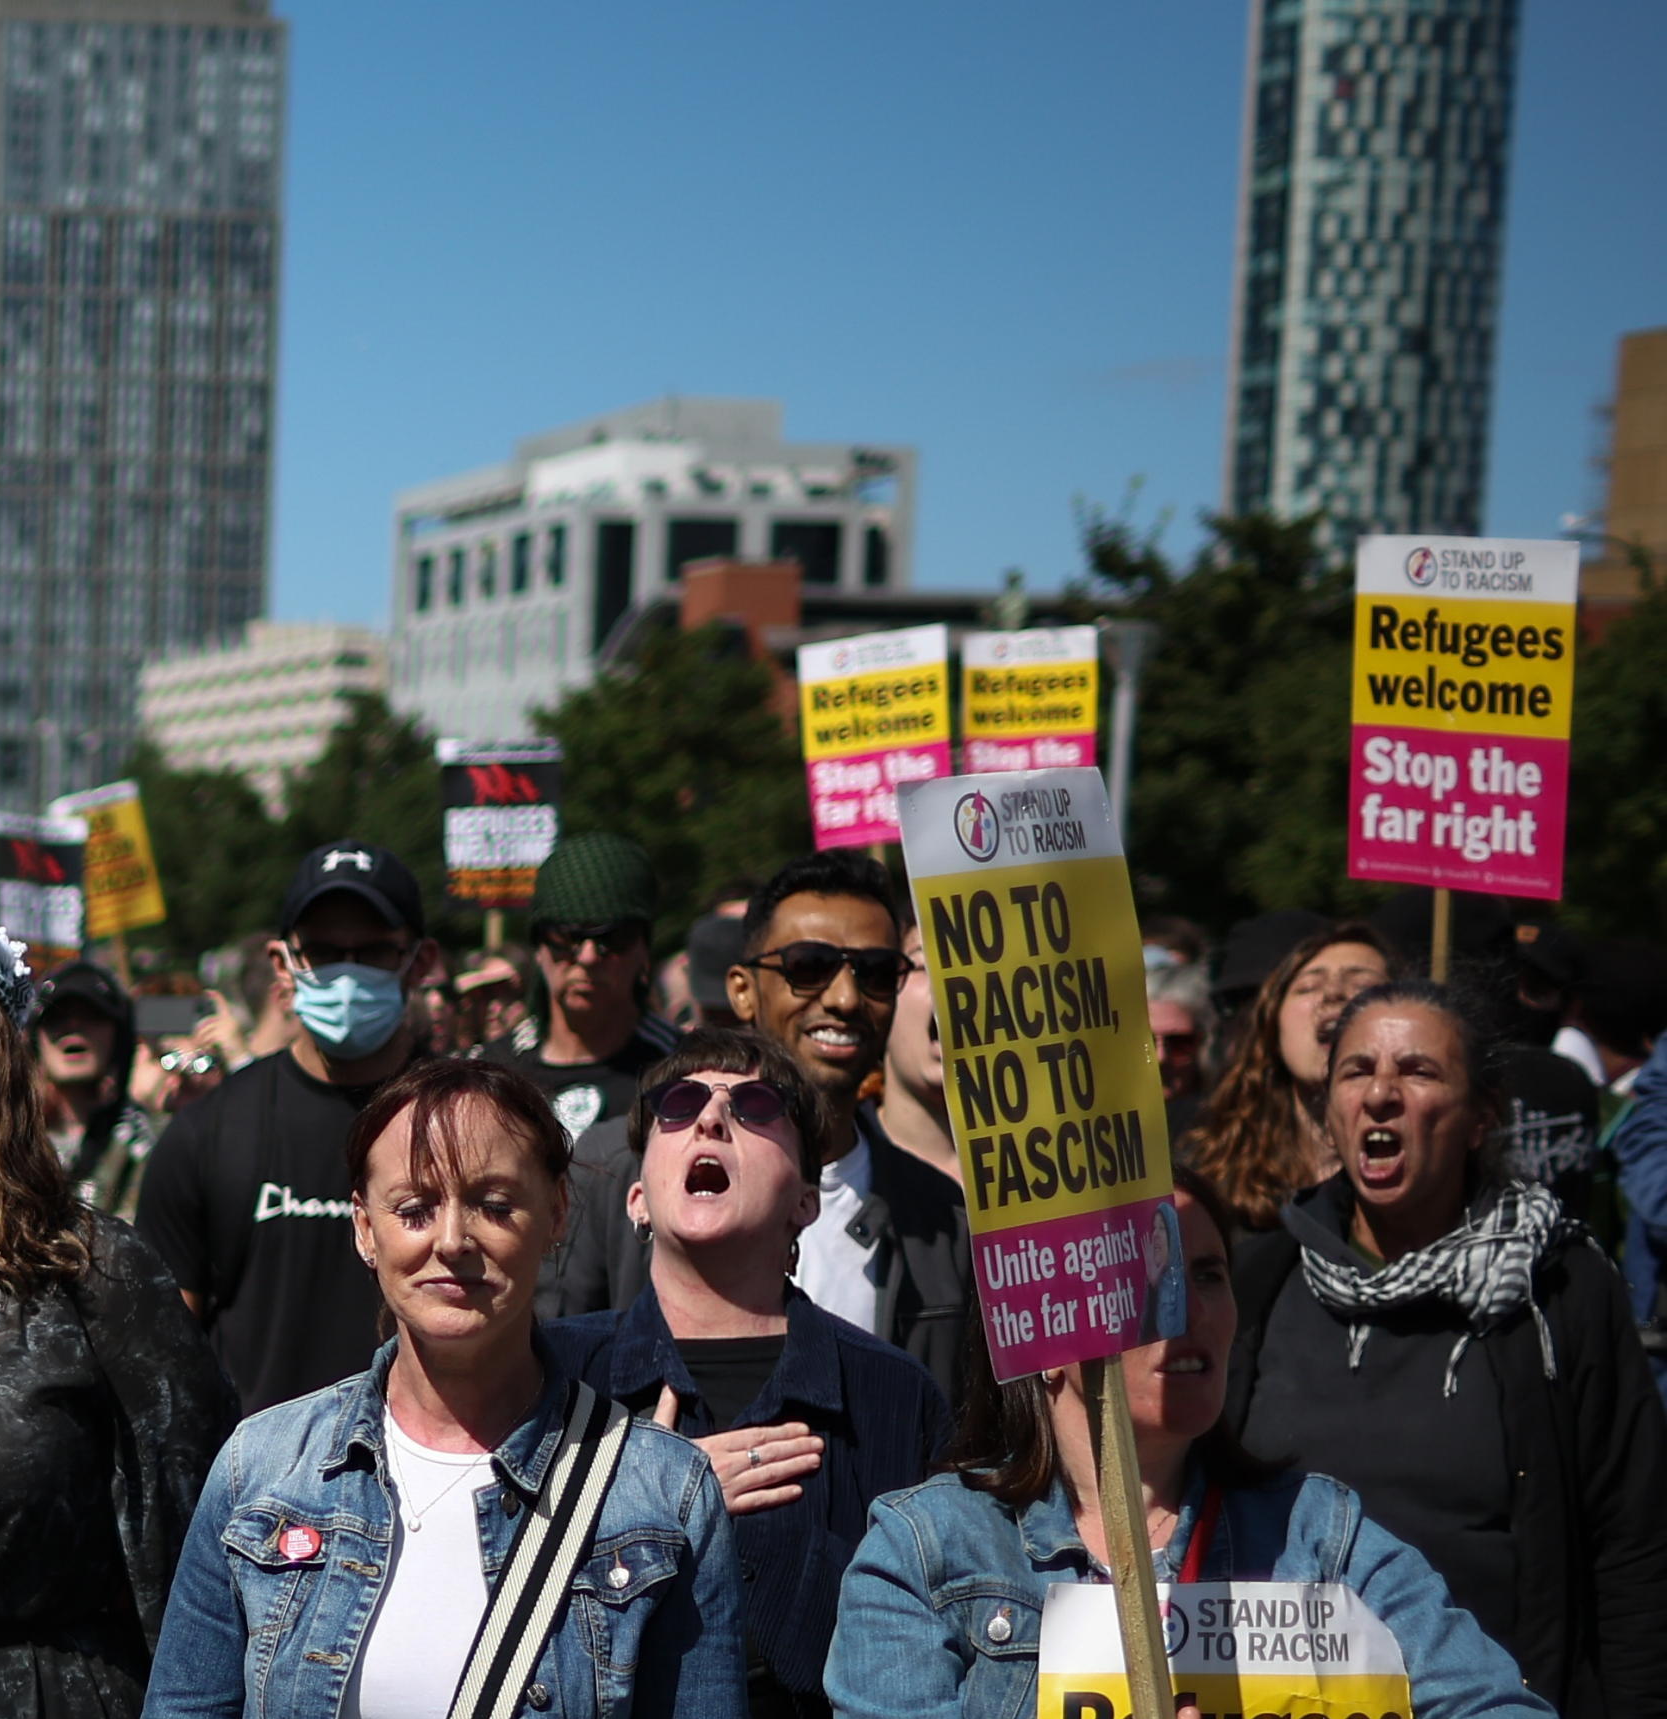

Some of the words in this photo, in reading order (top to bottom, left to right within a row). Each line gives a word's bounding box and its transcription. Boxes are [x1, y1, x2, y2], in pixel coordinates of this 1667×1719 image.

[1441, 549, 1496, 570] STAND
[1500, 550, 1526, 571] UP
[1441, 570, 1461, 590] TO
[1466, 571, 1534, 593] RACISM
[1369, 604, 1566, 668] Refugees
[810, 674, 939, 712] Refugees
[971, 671, 1089, 698] Refugees
[1367, 664, 1553, 719] welcome
[814, 711, 936, 745] welcome
[972, 704, 1083, 726] welcome
[811, 759, 882, 795] Stop
[883, 750, 937, 784] the
[1363, 735, 1459, 802] Stop
[1468, 745, 1543, 798] the
[1001, 789, 1053, 822] STAND
[1053, 787, 1072, 816] UP
[1004, 827, 1030, 857] TO
[1031, 820, 1087, 853] RACISM
[1359, 792, 1425, 843] far
[1431, 801, 1538, 863] right
[929, 888, 1005, 969] NO
[1009, 881, 1071, 958] TO
[943, 956, 1120, 1051] RACISM,
[954, 1049, 1029, 1131] NO
[1037, 1038, 1096, 1115] TO
[968, 1109, 1147, 1212] FASCISM
[982, 1238, 1056, 1291] Unite
[1063, 1218, 1139, 1282] against
[989, 1301, 1035, 1349] the
[1040, 1292, 1079, 1338] far
[1086, 1276, 1138, 1336] right
[1197, 1598, 1301, 1630] STAND
[1306, 1599, 1336, 1630] UP
[1197, 1631, 1237, 1662] TO
[1247, 1632, 1350, 1663] RACISM
